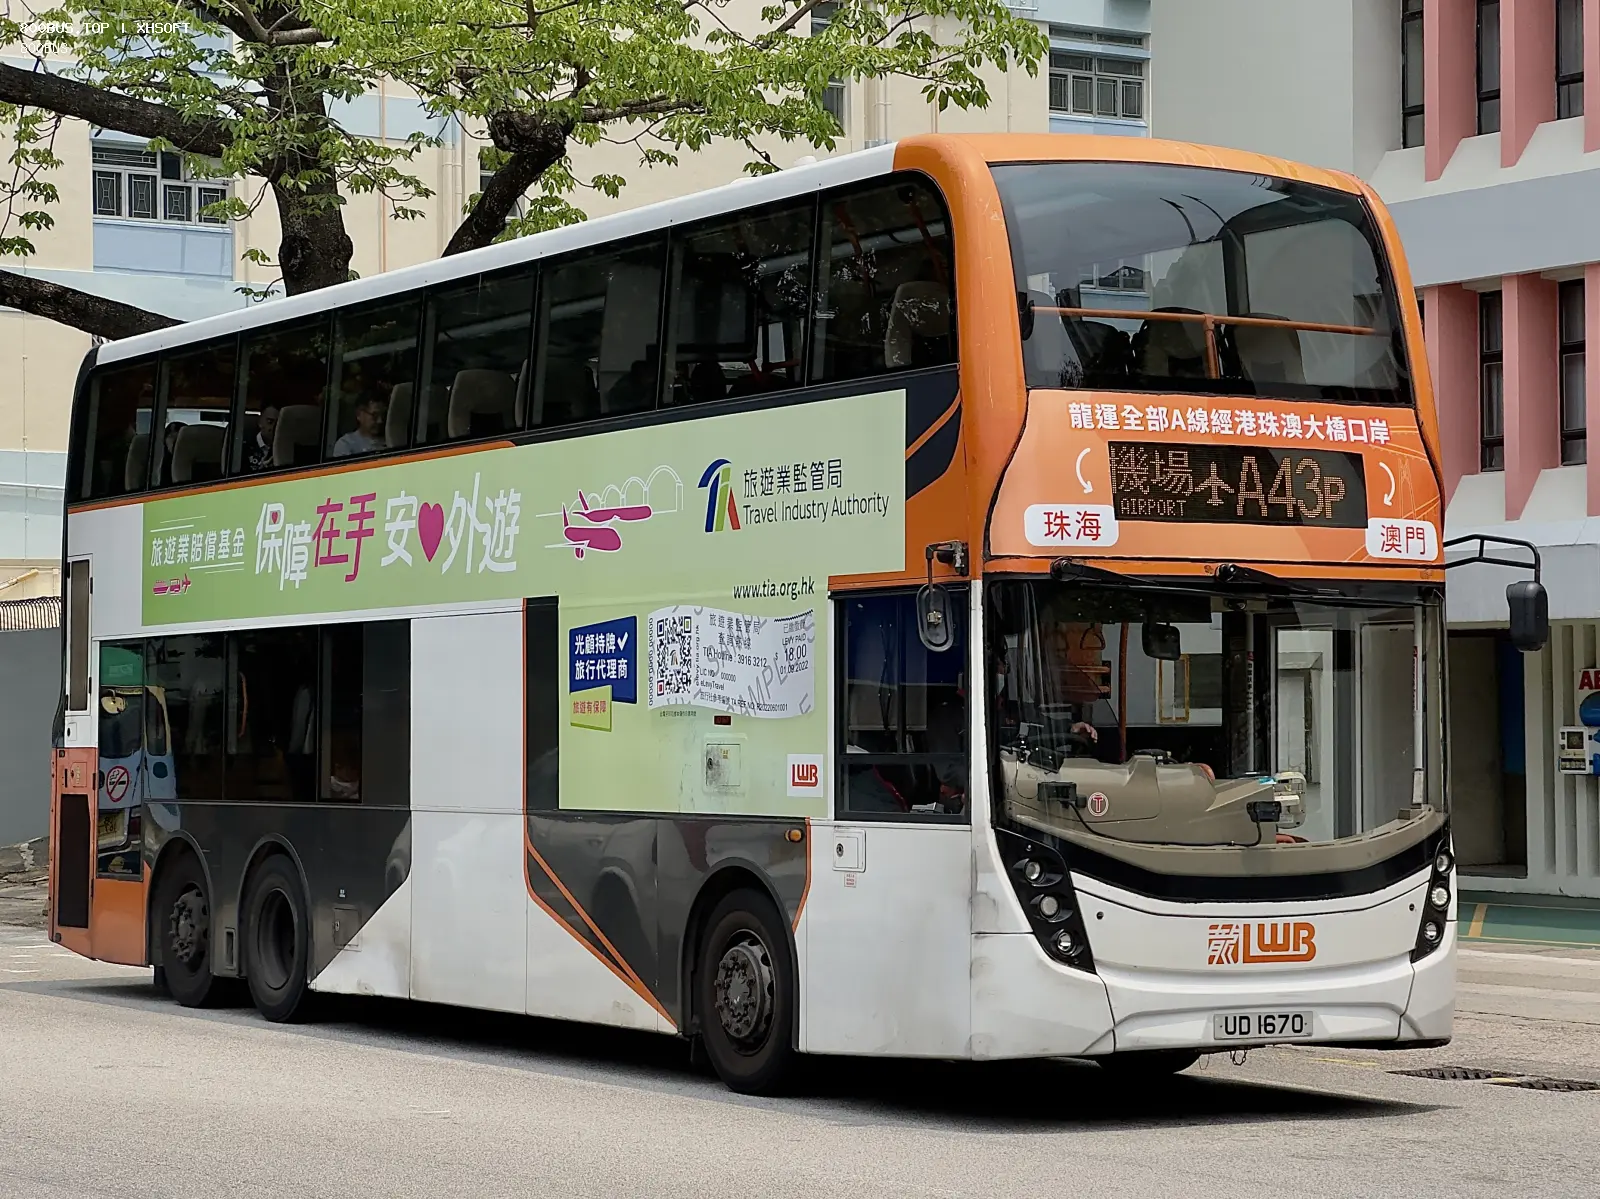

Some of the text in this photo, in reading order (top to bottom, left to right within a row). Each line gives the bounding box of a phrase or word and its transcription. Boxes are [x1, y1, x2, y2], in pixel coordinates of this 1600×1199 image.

[1068, 402, 1392, 445] 龍運全部A線經港珠澳大橋口岸
[743, 458, 842, 498] 旅遊業監管局
[1109, 445, 1193, 497] 機場
[1236, 455, 1346, 520] A43P
[743, 491, 890, 525] Travel Industry Authority
[1119, 498, 1188, 518] AIRPORT
[1042, 510, 1103, 541] 珠海
[150, 527, 245, 567] 旅遊業賠償基金
[1379, 524, 1427, 555] 澳門
[733, 576, 815, 600] www.tia.org.hk
[574, 632, 616, 655] 光顧持牌
[785, 643, 807, 662] 18.00
[574, 658, 628, 680] 旅行代理商
[737, 653, 752, 666] 3916
[752, 656, 768, 668] 3212
[573, 700, 607, 715] 旅遊有保障
[791, 763, 819, 787] LWB
[1242, 922, 1317, 964] LWB
[1224, 1013, 1304, 1036] UD 1670
